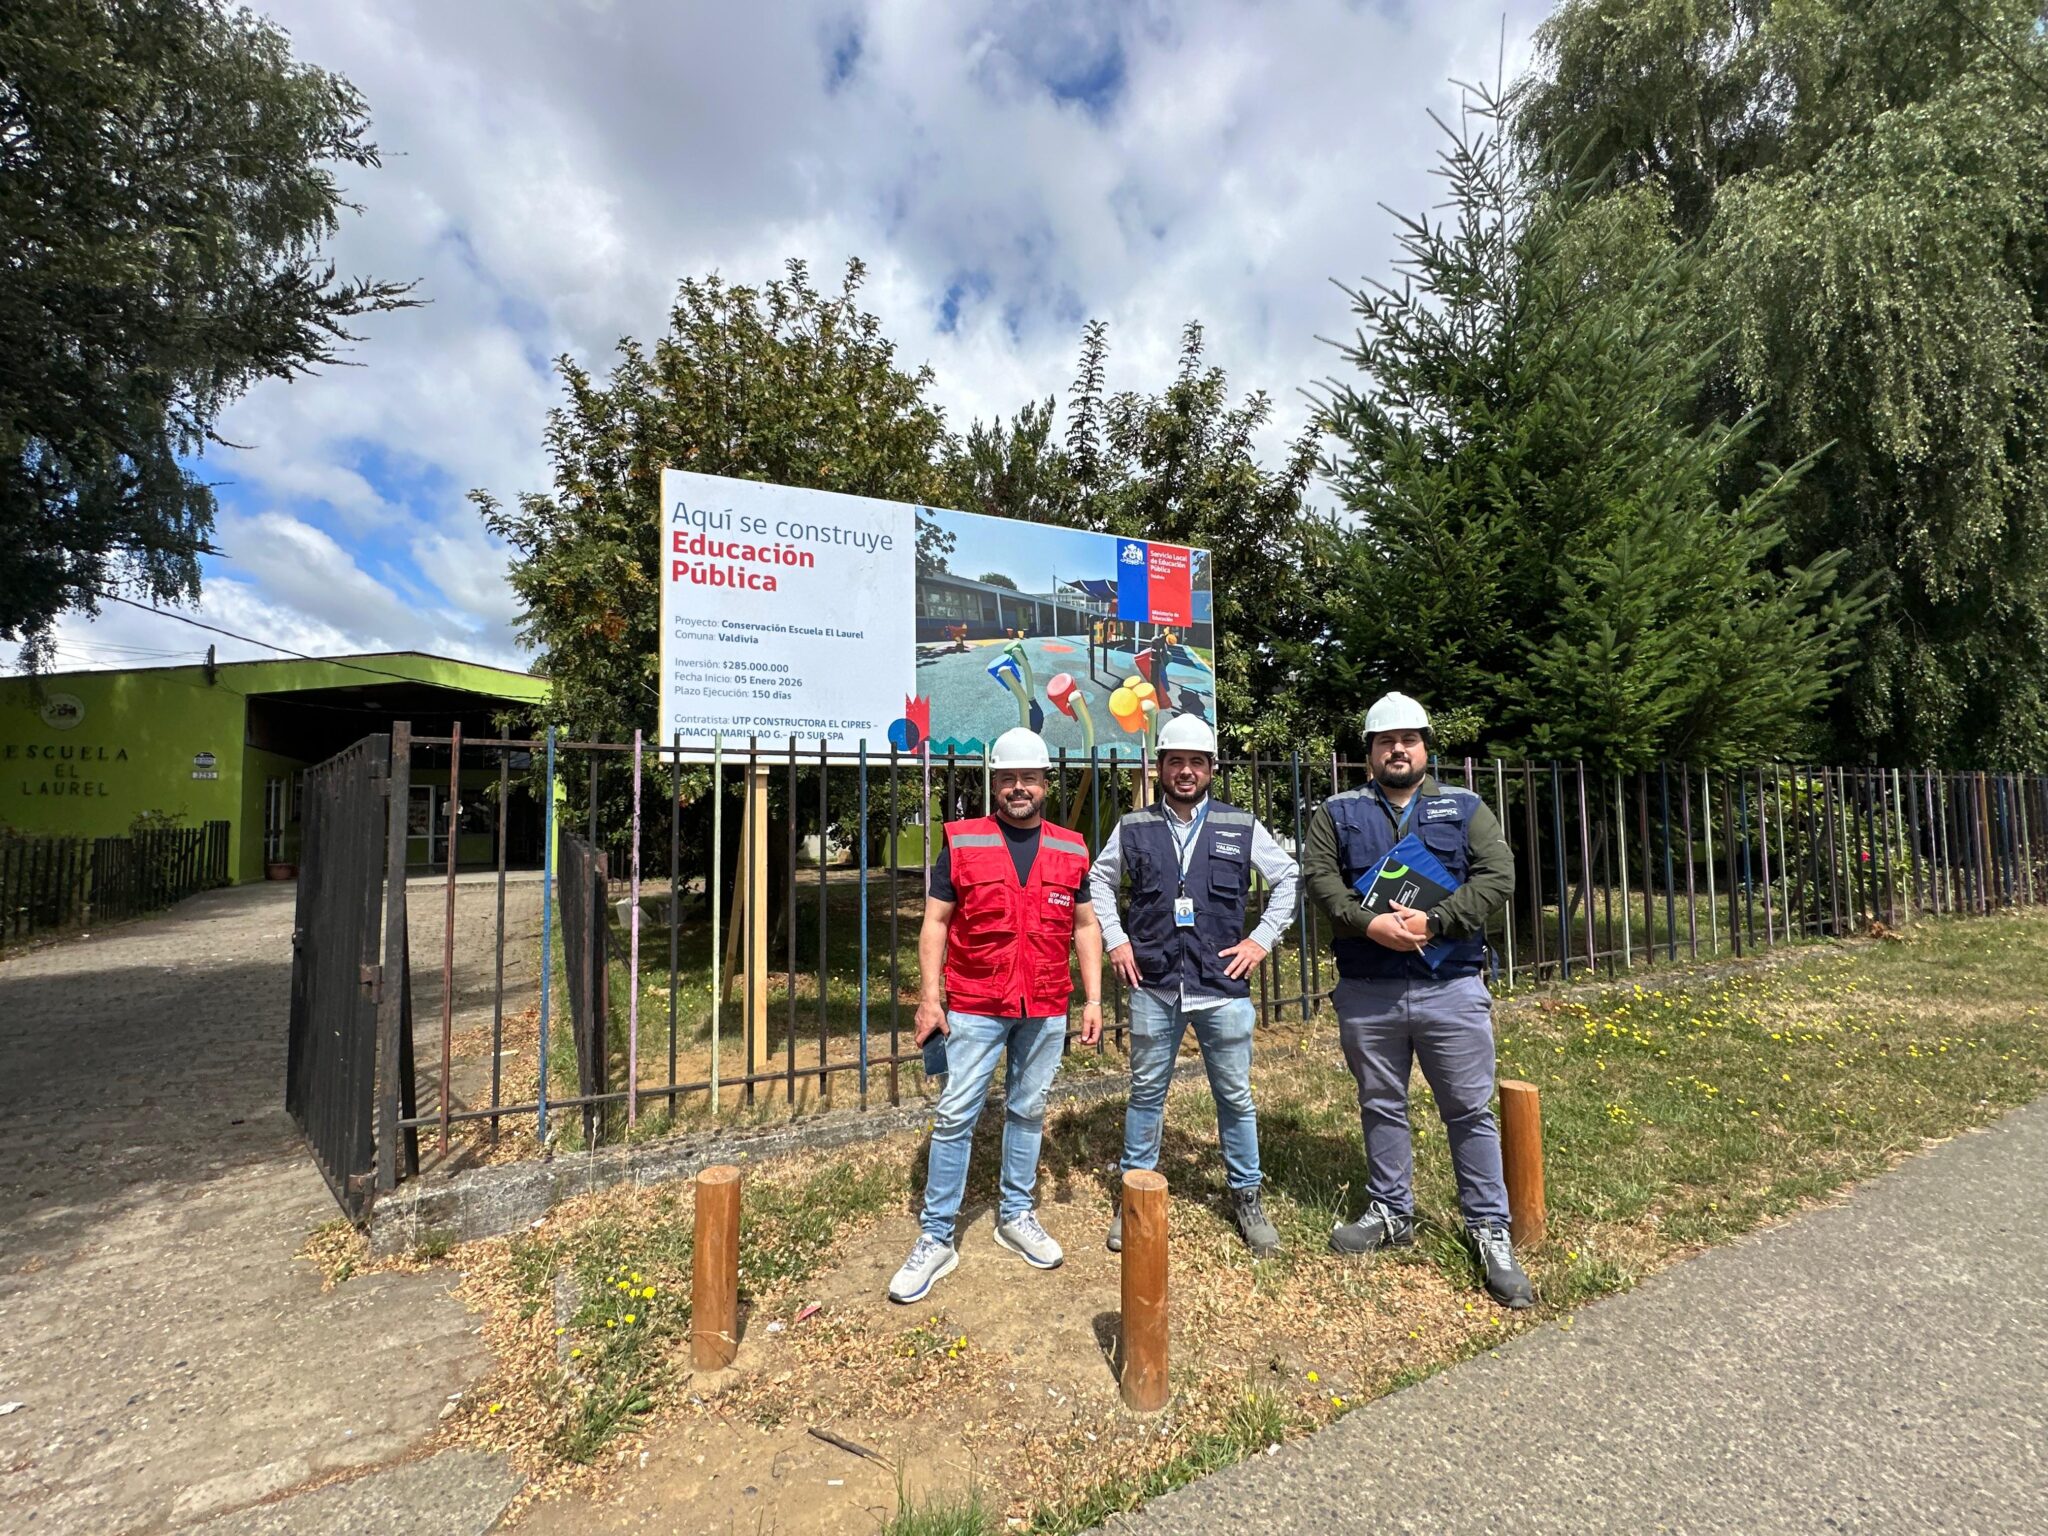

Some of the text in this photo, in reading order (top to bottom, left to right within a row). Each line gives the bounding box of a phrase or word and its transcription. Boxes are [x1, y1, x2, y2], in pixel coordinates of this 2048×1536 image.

[672, 502, 893, 553] Aquí se construye
[673, 531, 815, 568] Educación
[1150, 550, 1172, 559] Servicio
[1151, 565, 1170, 573] Pública
[1159, 560, 1186, 568] Educación
[672, 560, 777, 592] Pública
[675, 615, 864, 639] Proyecto: Conservación Escuela El Laurel
[675, 630, 758, 645] Comuna: Valdivia
[675, 658, 789, 673] Inversión: $285.000.000
[675, 672, 802, 687] Fecha Inicio: 05 Enero 2026
[675, 686, 791, 700] Plazo Ejecución: 150 días
[674, 714, 729, 724] Contratista:
[732, 717, 750, 725] UTP
[753, 717, 826, 728] CONSTRUCTORA
[829, 719, 839, 728] EL
[841, 720, 871, 729] CIPRES
[675, 727, 717, 736] IGNACIO
[807, 731, 825, 740] SUR
[827, 732, 844, 740] SPA
[5, 745, 128, 761] ESCUELA
[56, 764, 79, 778] EL
[22, 781, 109, 796] LAUREL
